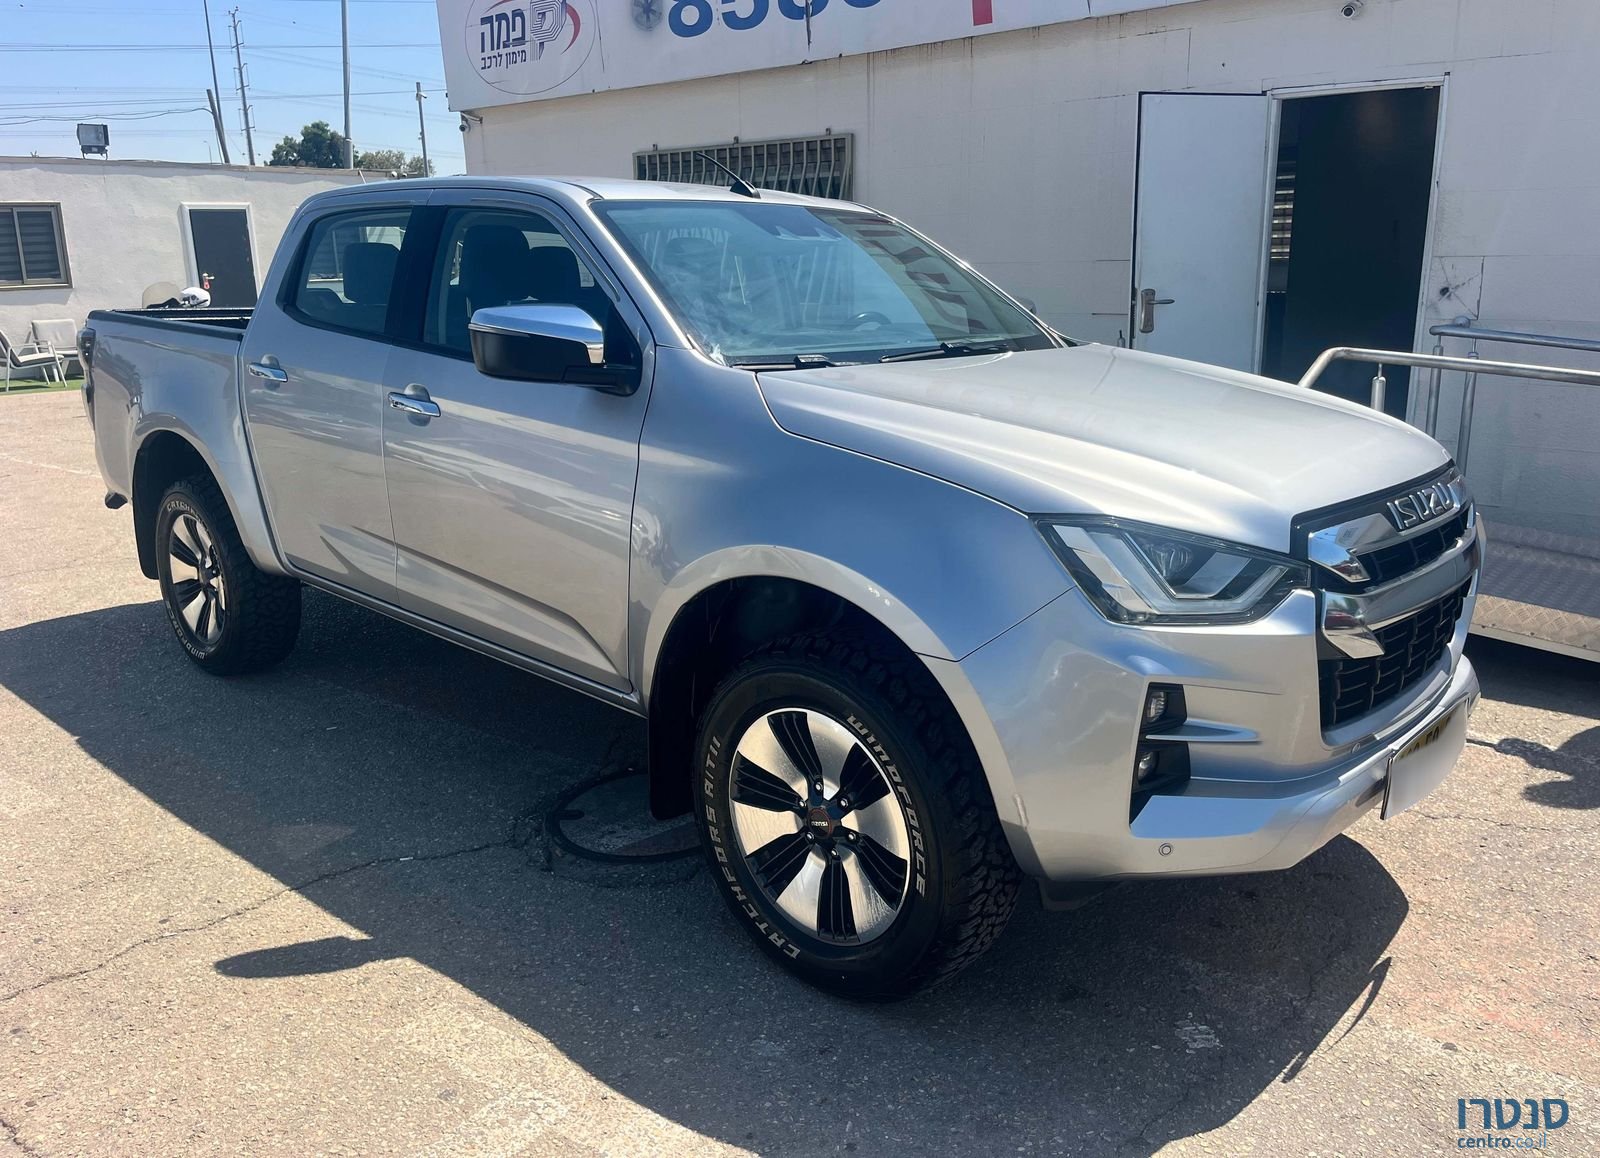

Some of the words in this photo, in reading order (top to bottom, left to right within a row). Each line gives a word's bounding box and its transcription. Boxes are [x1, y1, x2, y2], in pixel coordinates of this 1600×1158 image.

[480, 8, 527, 53] פמה
[480, 50, 504, 71] לרכב
[504, 49, 527, 69] מימון
[1386, 482, 1452, 530] ISUZU
